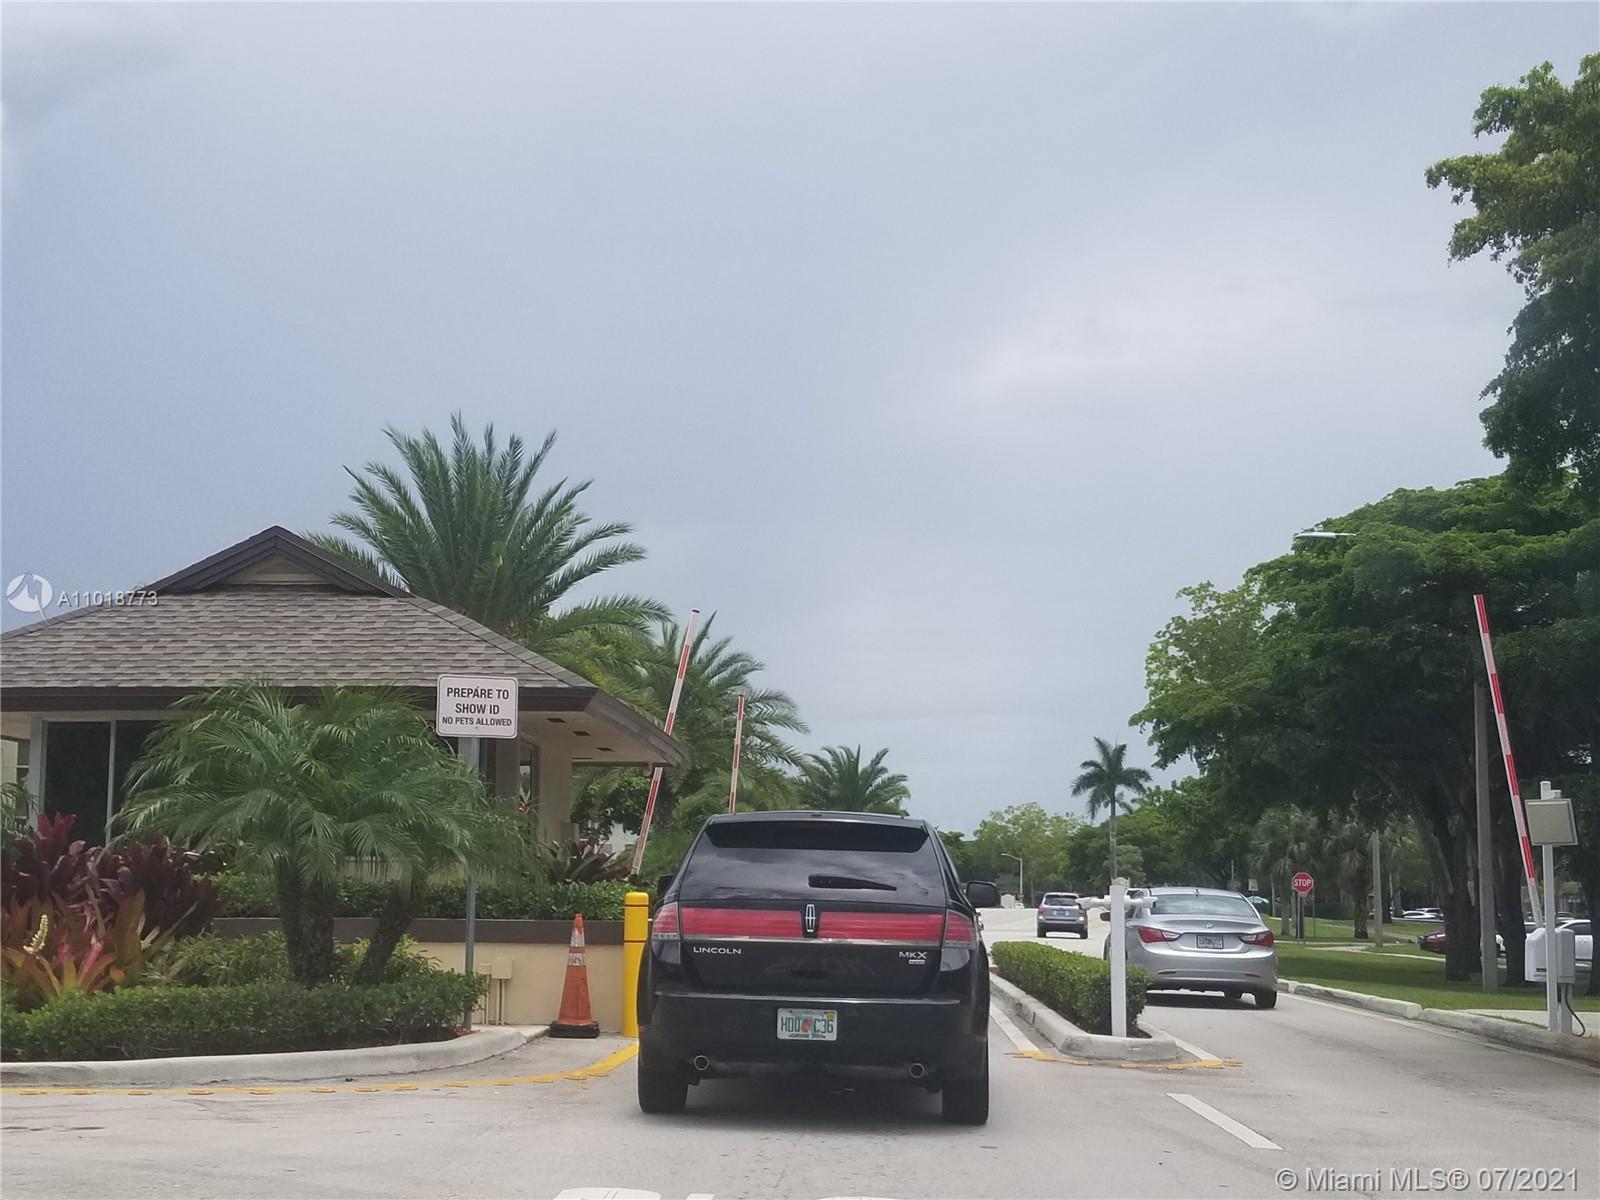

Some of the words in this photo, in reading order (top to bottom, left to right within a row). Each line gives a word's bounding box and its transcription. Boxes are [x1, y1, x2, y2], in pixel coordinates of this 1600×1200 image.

[447, 687, 493, 699] PREPARE
[496, 689, 509, 700] TO
[455, 703, 487, 715] SHOW
[489, 704, 500, 715] ID
[442, 716, 453, 725] NO
[455, 717, 474, 725] PETS
[476, 718, 512, 726] ALLOWED
[1294, 878, 1312, 887] STOP
[693, 946, 742, 955] LINCOLN
[898, 951, 928, 959] MKX
